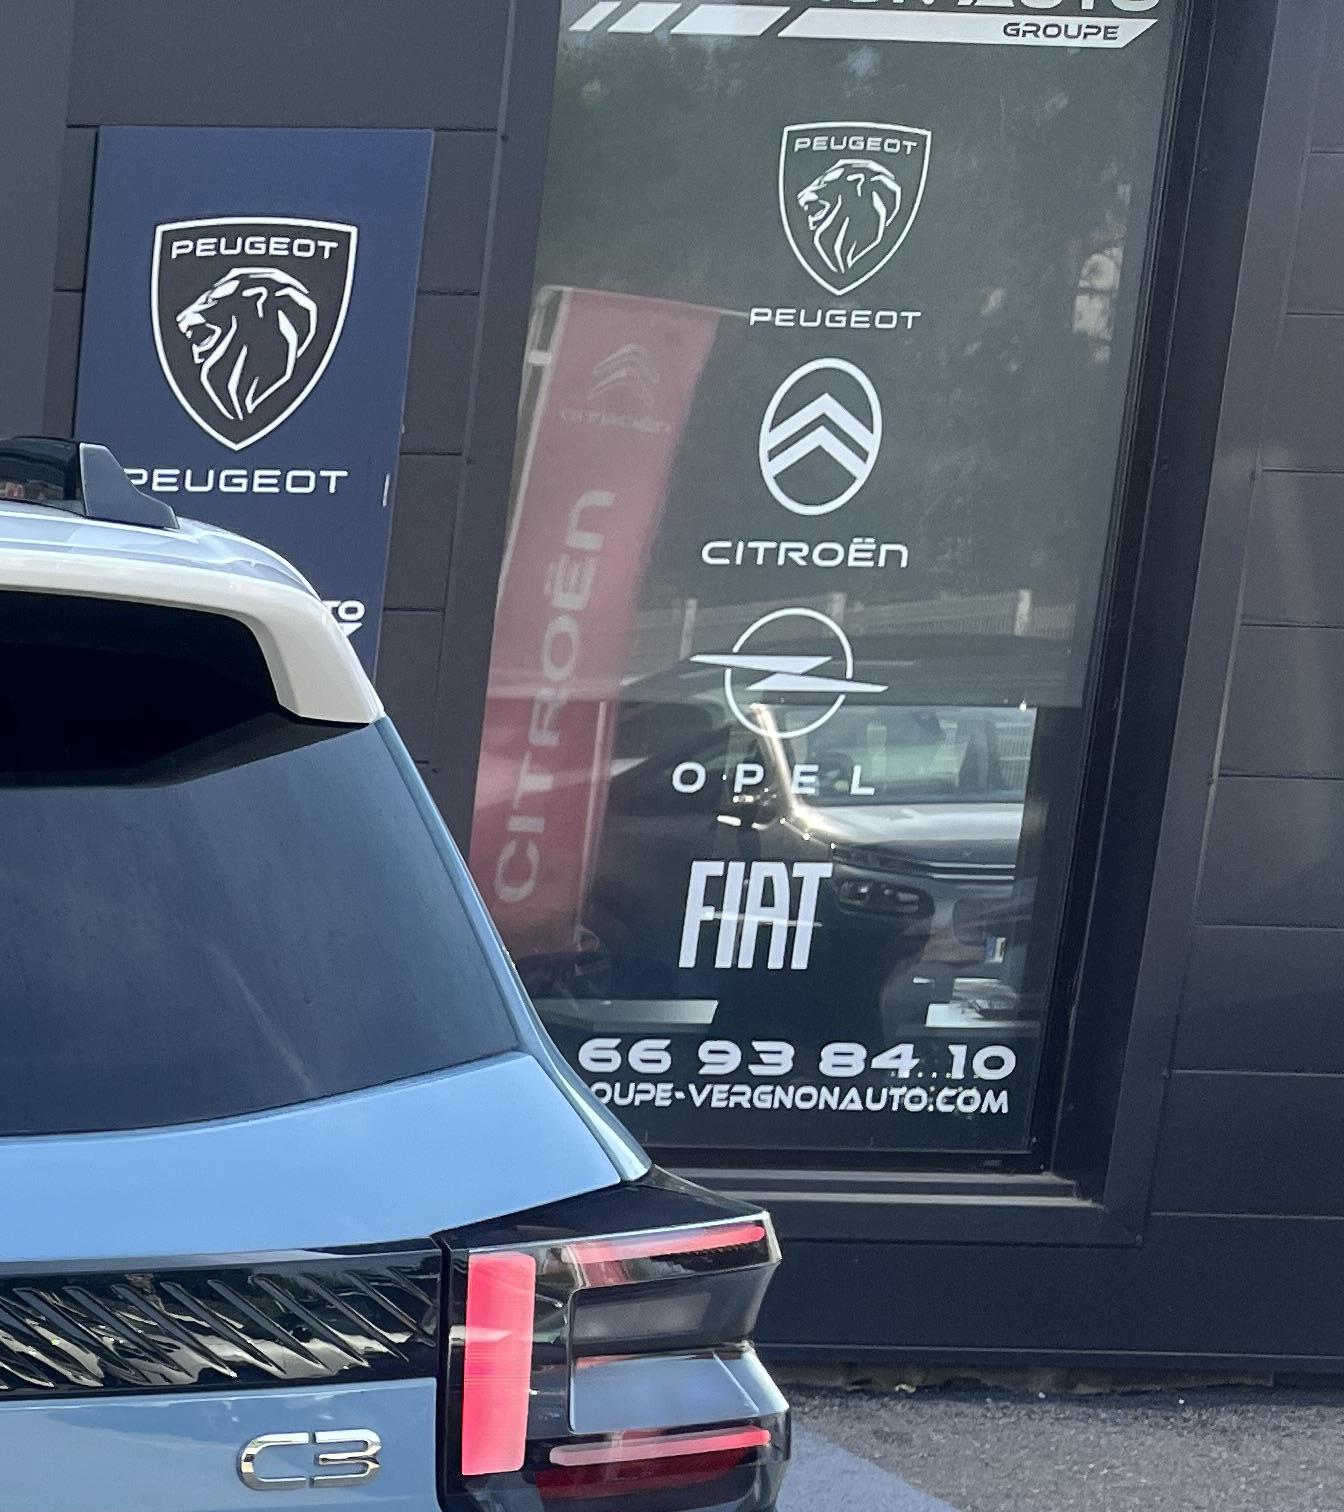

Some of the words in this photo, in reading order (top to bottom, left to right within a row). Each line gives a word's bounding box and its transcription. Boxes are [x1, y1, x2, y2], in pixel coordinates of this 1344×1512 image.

[1003, 22, 1120, 40] GROUPE
[794, 135, 918, 155] PEUGEOT
[171, 236, 339, 260] PEUGEOT
[749, 307, 922, 330] PEUGEOT
[123, 468, 349, 494] PEUGEOT
[701, 537, 909, 568] CITROËN
[672, 761, 876, 797] OPEL
[678, 860, 834, 970] FIAT
[578, 1037, 672, 1073] 66
[697, 1039, 796, 1076] 93
[818, 1041, 920, 1078] 84
[948, 1044, 1016, 1080] 10
[236, 1428, 382, 1490] C3
